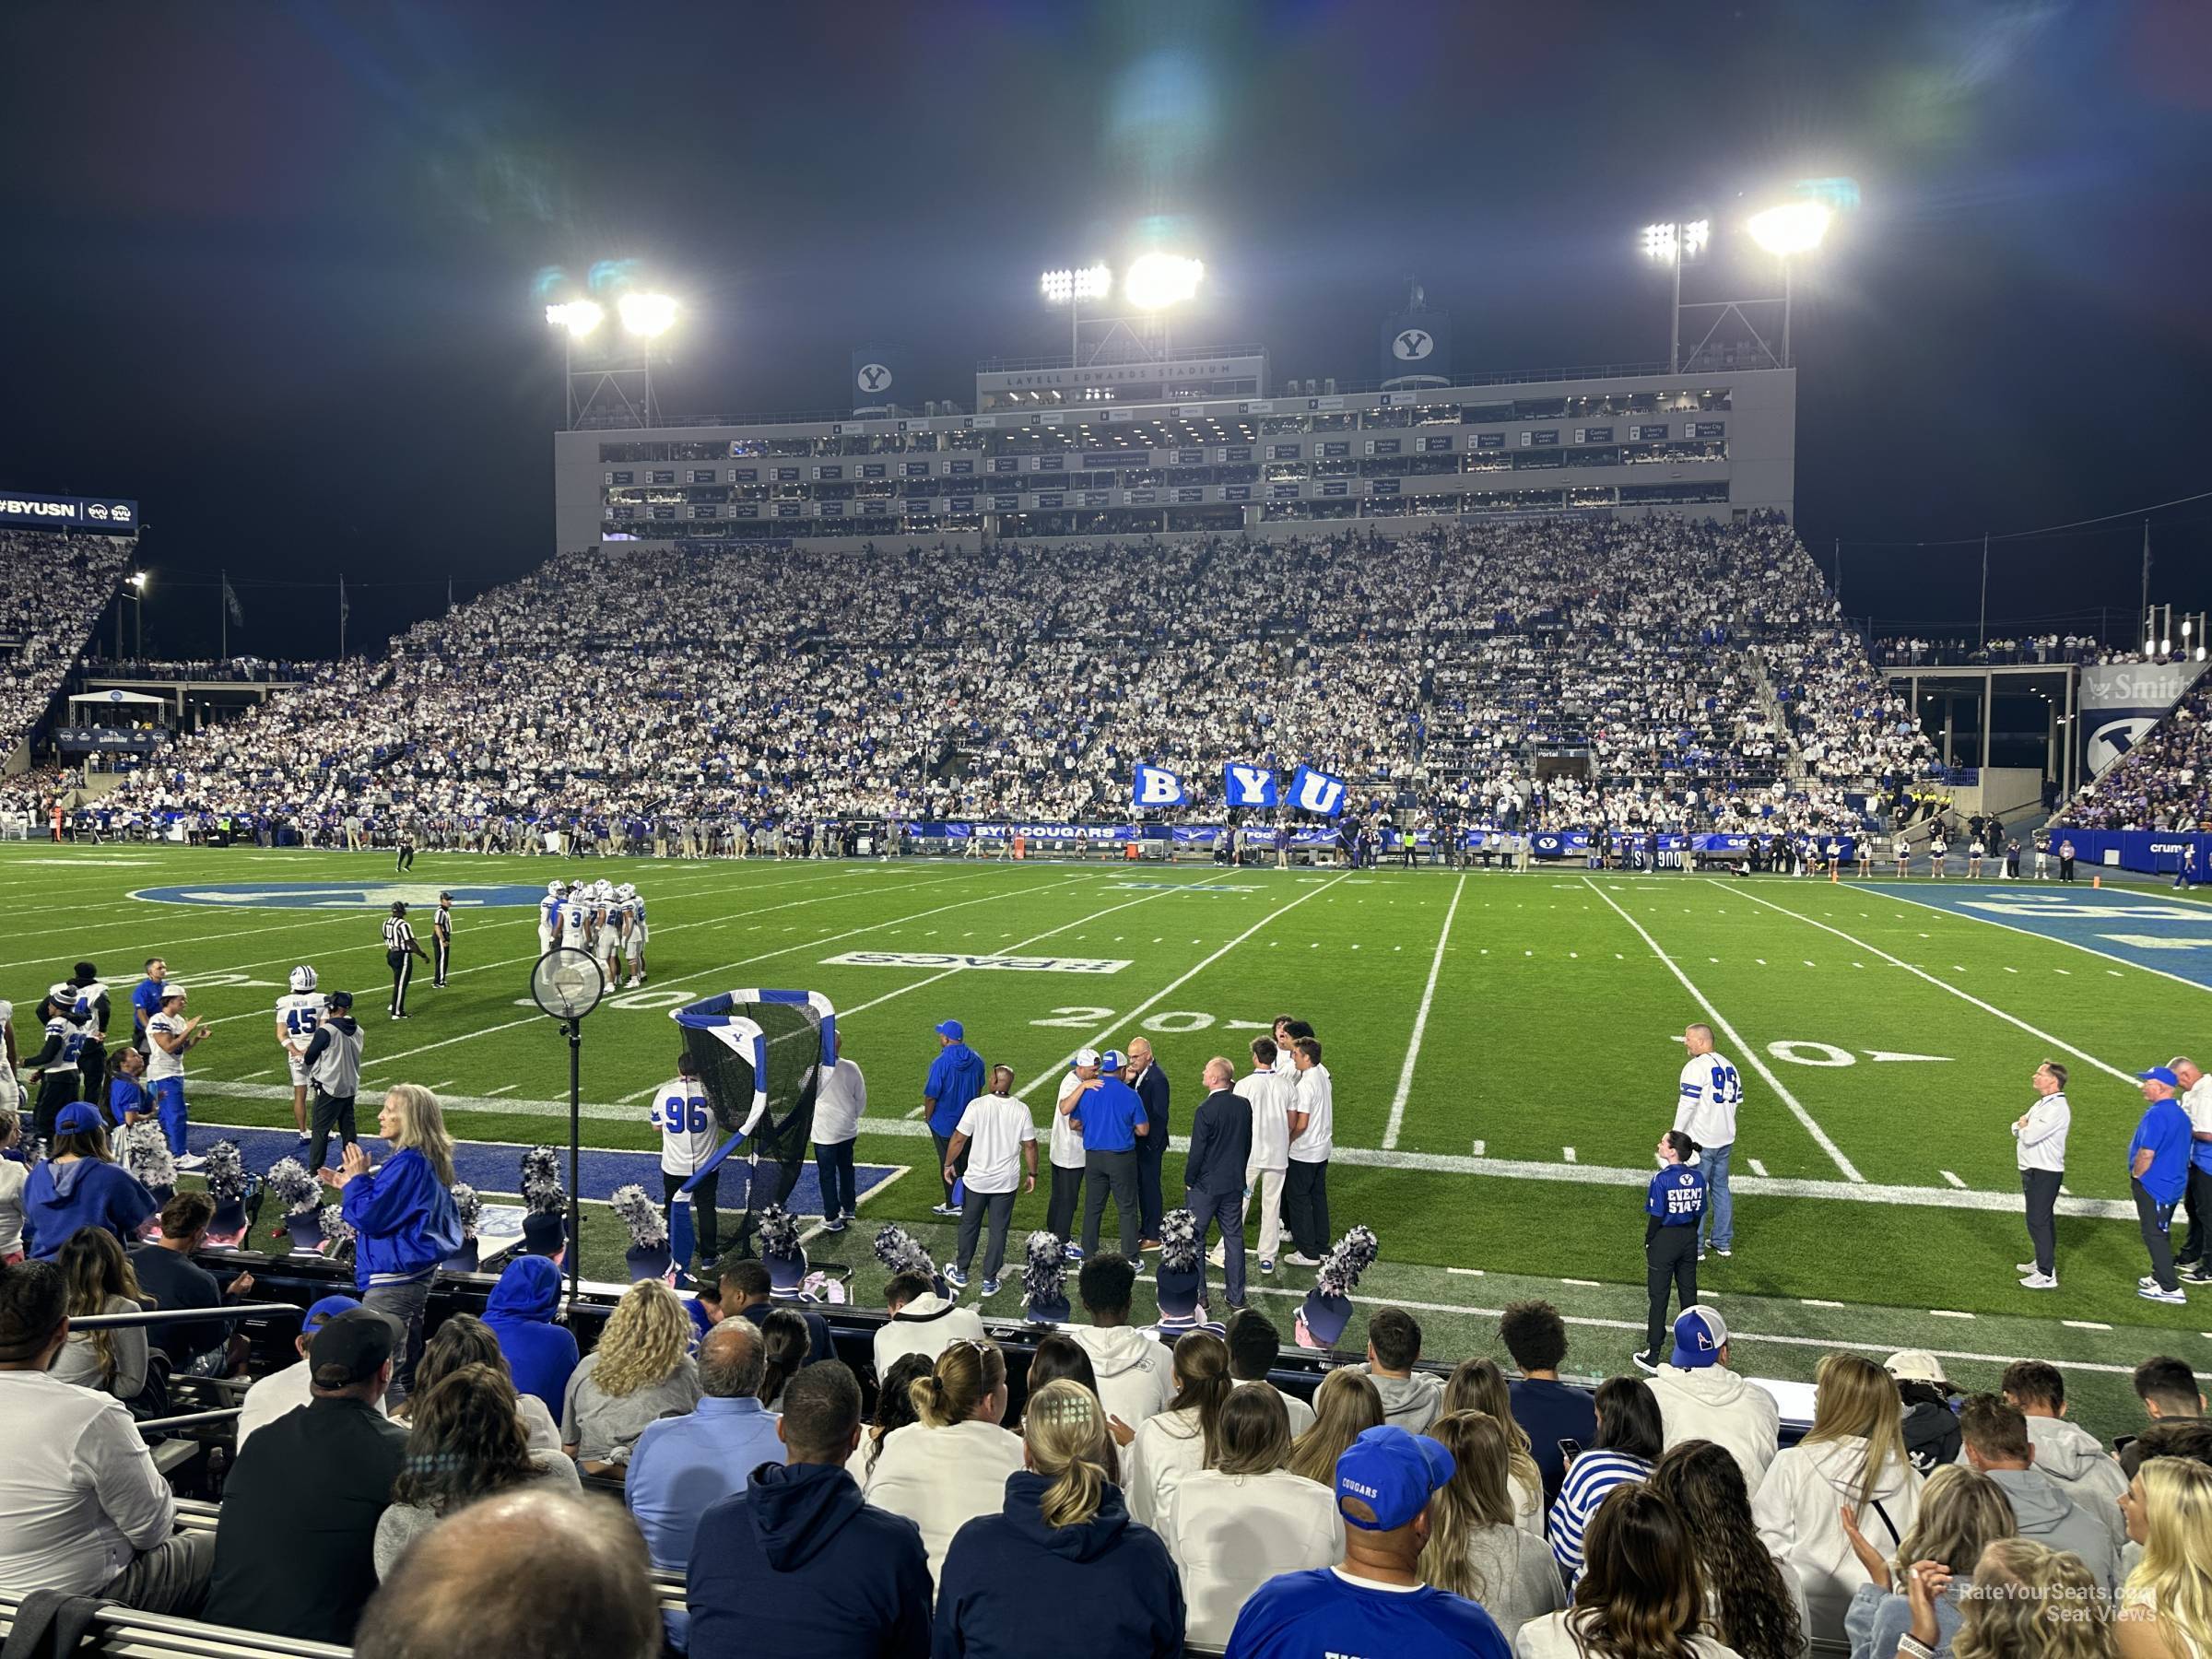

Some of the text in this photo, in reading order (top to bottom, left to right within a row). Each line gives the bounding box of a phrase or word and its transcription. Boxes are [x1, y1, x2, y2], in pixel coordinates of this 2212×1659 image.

[1006, 365, 1230, 385] LAVELL EDWARDS STADIUM
[1140, 767, 1343, 813] B Y U
[1019, 827, 1115, 838] COUGARS
[2150, 843, 2196, 854] cruml
[571, 911, 582, 928] 3
[287, 1008, 317, 1035] 45
[666, 1096, 707, 1134] 96
[1667, 1187, 1702, 1202] EVENT
[1668, 1200, 1702, 1214] STAFF
[1342, 1477, 1378, 1499] COUGARS
